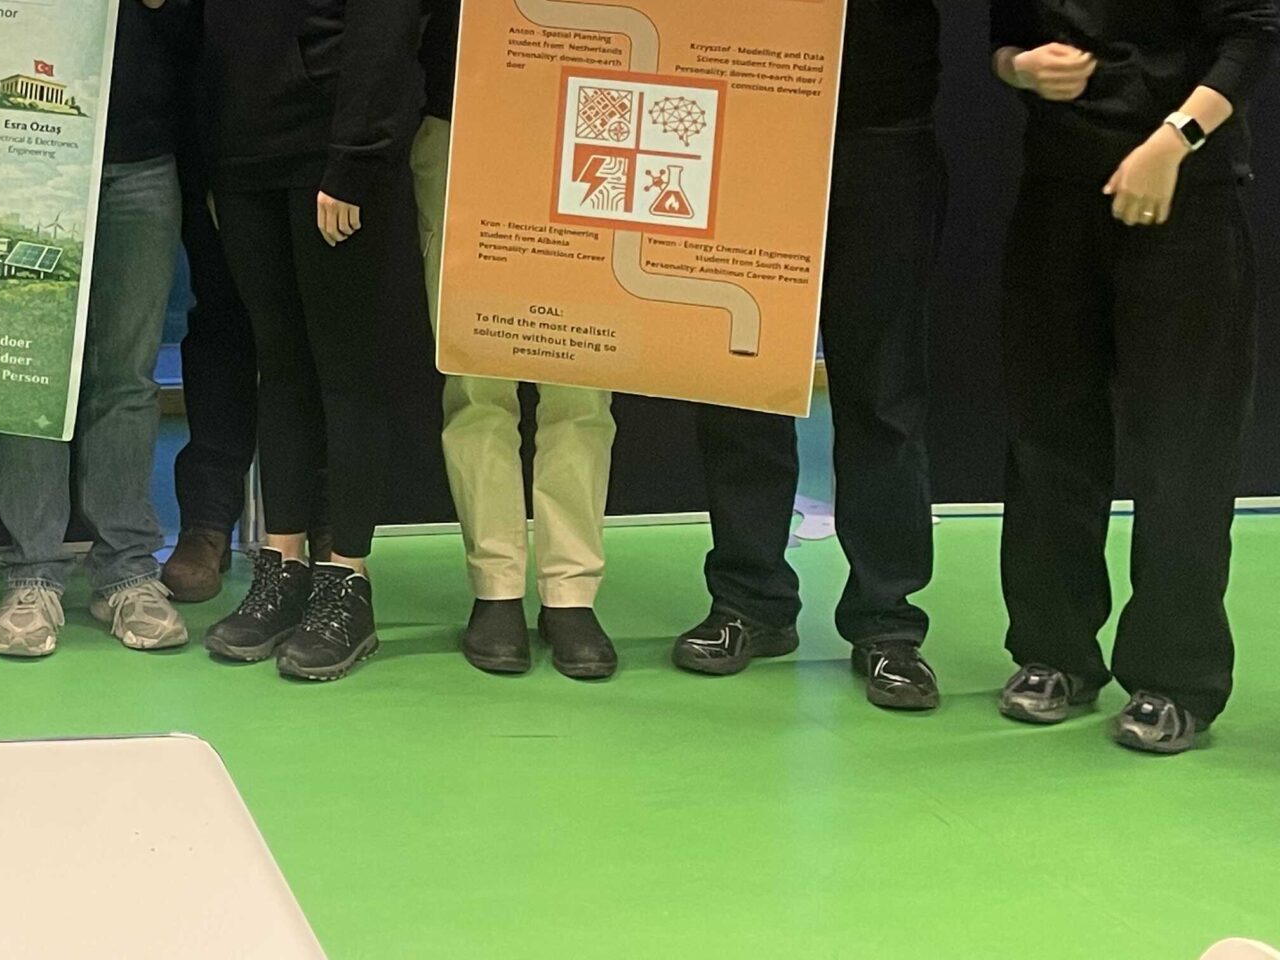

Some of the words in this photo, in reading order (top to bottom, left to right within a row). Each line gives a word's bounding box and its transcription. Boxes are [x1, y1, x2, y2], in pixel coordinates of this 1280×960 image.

[541, 29, 572, 39] Spatial
[573, 32, 612, 44] Planning
[508, 38, 541, 48] student
[543, 41, 565, 50] from
[568, 43, 623, 55] Netherlands
[737, 46, 782, 59] Modelling
[783, 51, 801, 60] and
[803, 52, 825, 62] Data
[696, 54, 730, 65] Science
[731, 59, 766, 69] student
[768, 61, 791, 71] from
[793, 63, 824, 74] Poland
[776, 85, 821, 97] developer
[4, 119, 28, 131] Esra
[34, 136, 79, 149] Electronics
[8, 145, 56, 159] Engineering
[480, 231, 513, 241] student
[537, 236, 570, 247] Albania
[508, 221, 547, 233] Electrical
[548, 226, 600, 241] Engineering
[478, 252, 508, 262] Person
[530, 246, 575, 259] Ambitious
[576, 252, 606, 262] Career
[683, 241, 714, 253] Energy
[715, 244, 757, 257] Chemical
[758, 249, 811, 263] Engineering
[731, 256, 754, 267] from
[755, 259, 782, 271] South
[698, 265, 745, 279] Ambitious
[746, 270, 777, 281] Career
[778, 274, 809, 285] Person
[529, 304, 565, 318] GOAL:
[476, 312, 489, 322] To
[492, 314, 515, 326] find
[517, 318, 537, 329] the
[538, 321, 568, 332] most
[570, 325, 617, 338] realistic
[0, 335, 33, 349] doer
[473, 327, 520, 341] solution
[522, 333, 567, 347] without
[569, 338, 601, 352] being
[603, 342, 617, 352] so
[0, 352, 33, 366] doer
[512, 345, 576, 361] pessimistic
[2, 369, 50, 385] Person
